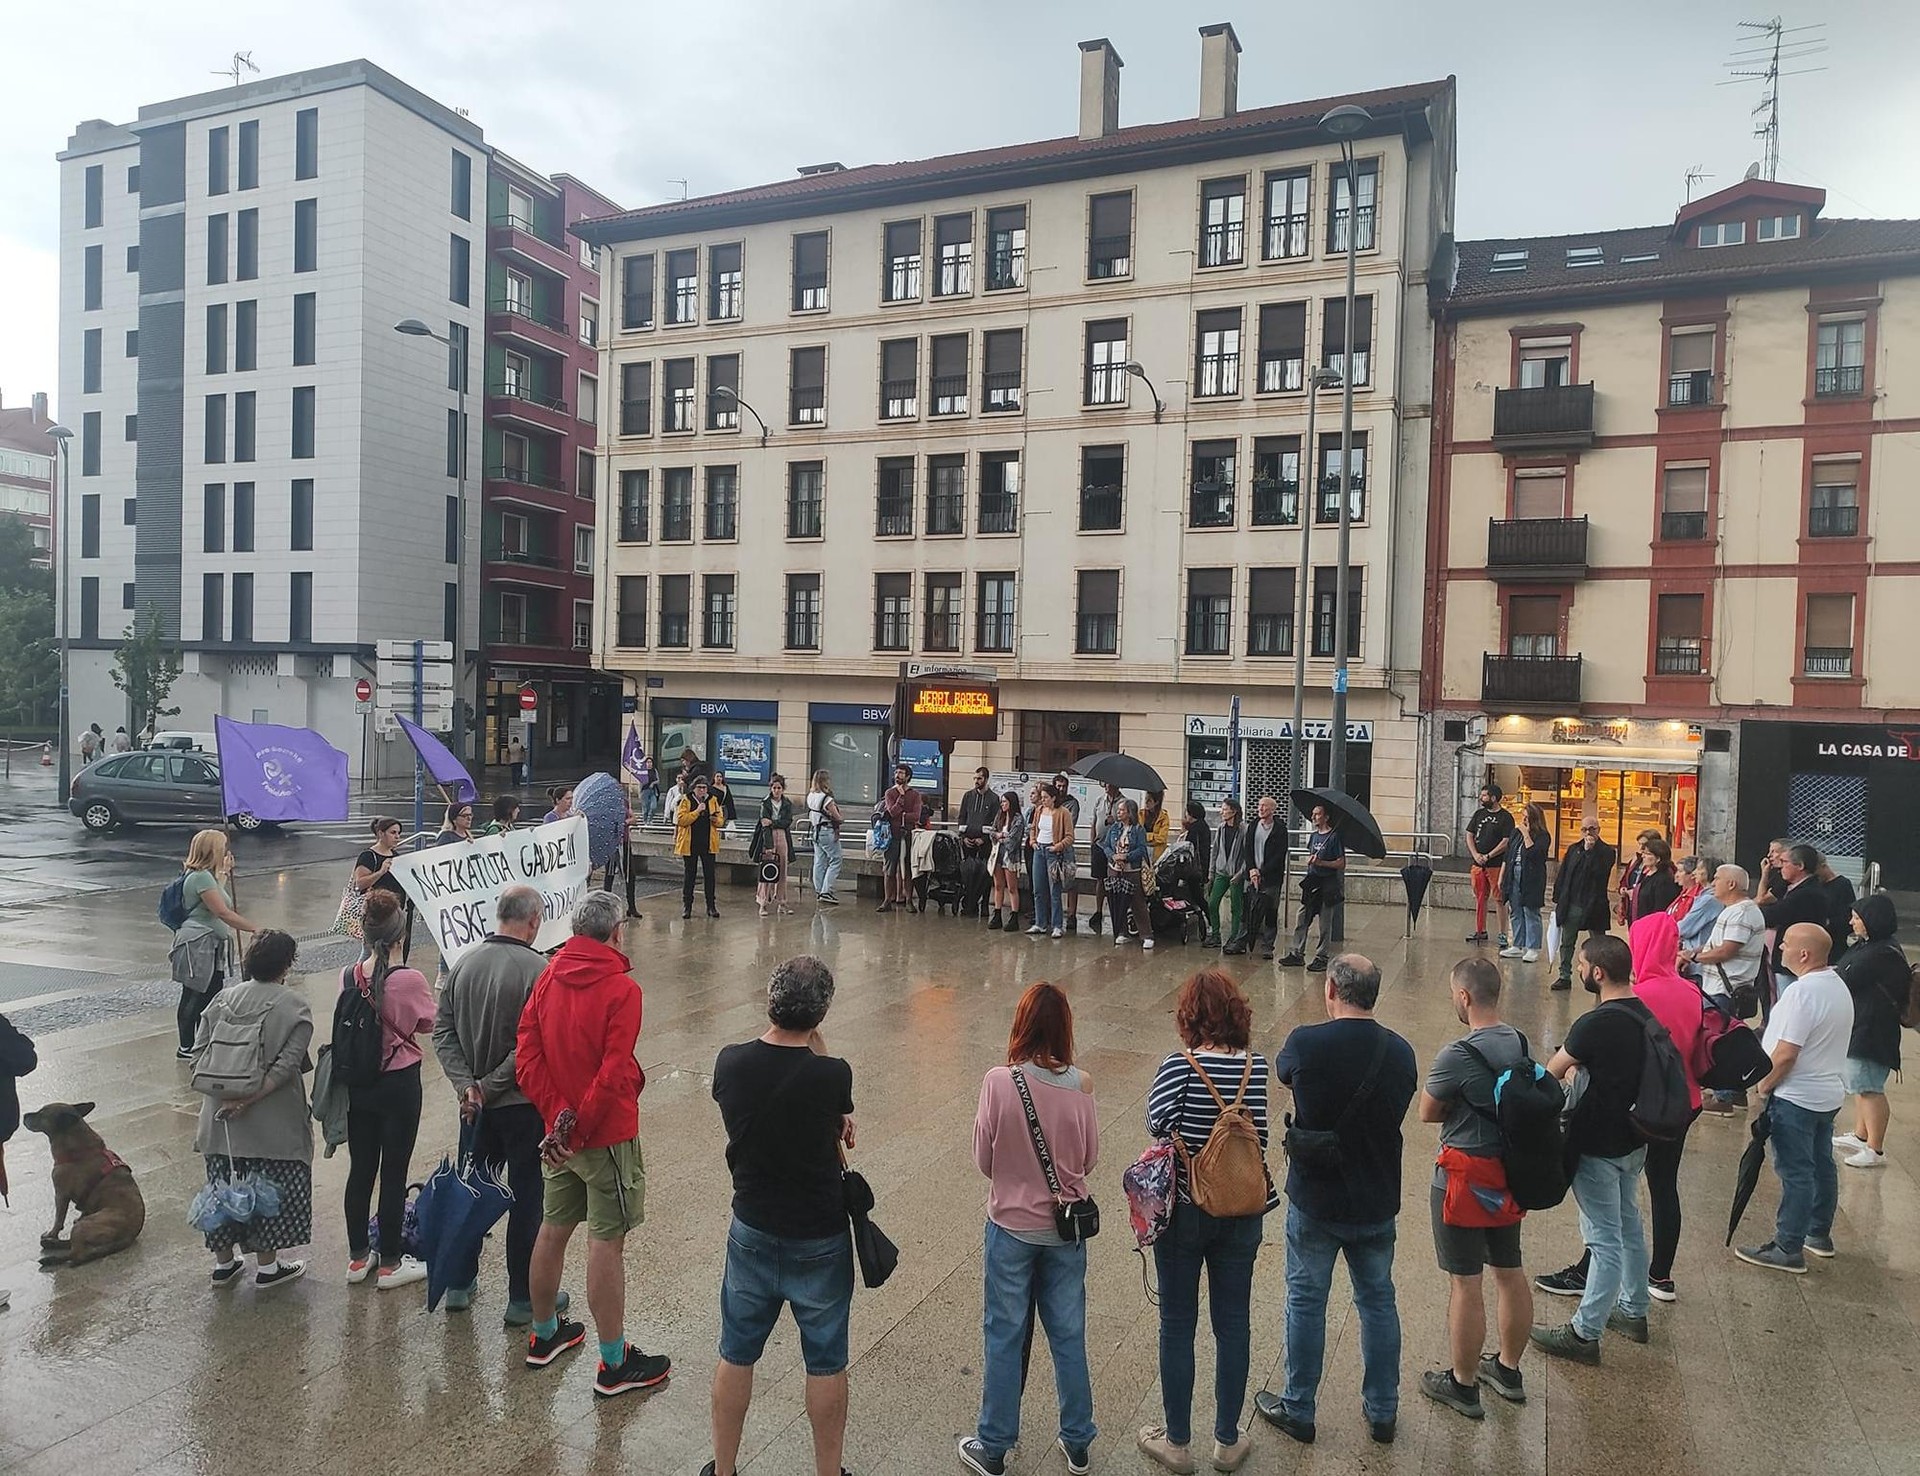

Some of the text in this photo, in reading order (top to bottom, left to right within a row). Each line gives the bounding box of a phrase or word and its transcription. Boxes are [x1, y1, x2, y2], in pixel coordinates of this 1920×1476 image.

[700, 703, 729, 714] BBVA
[1208, 725, 1274, 737] inmbiliaria
[1818, 743, 1908, 757] LA CASA DE
[411, 851, 515, 901] NAZKATUTA
[439, 900, 494, 950] ASKE
